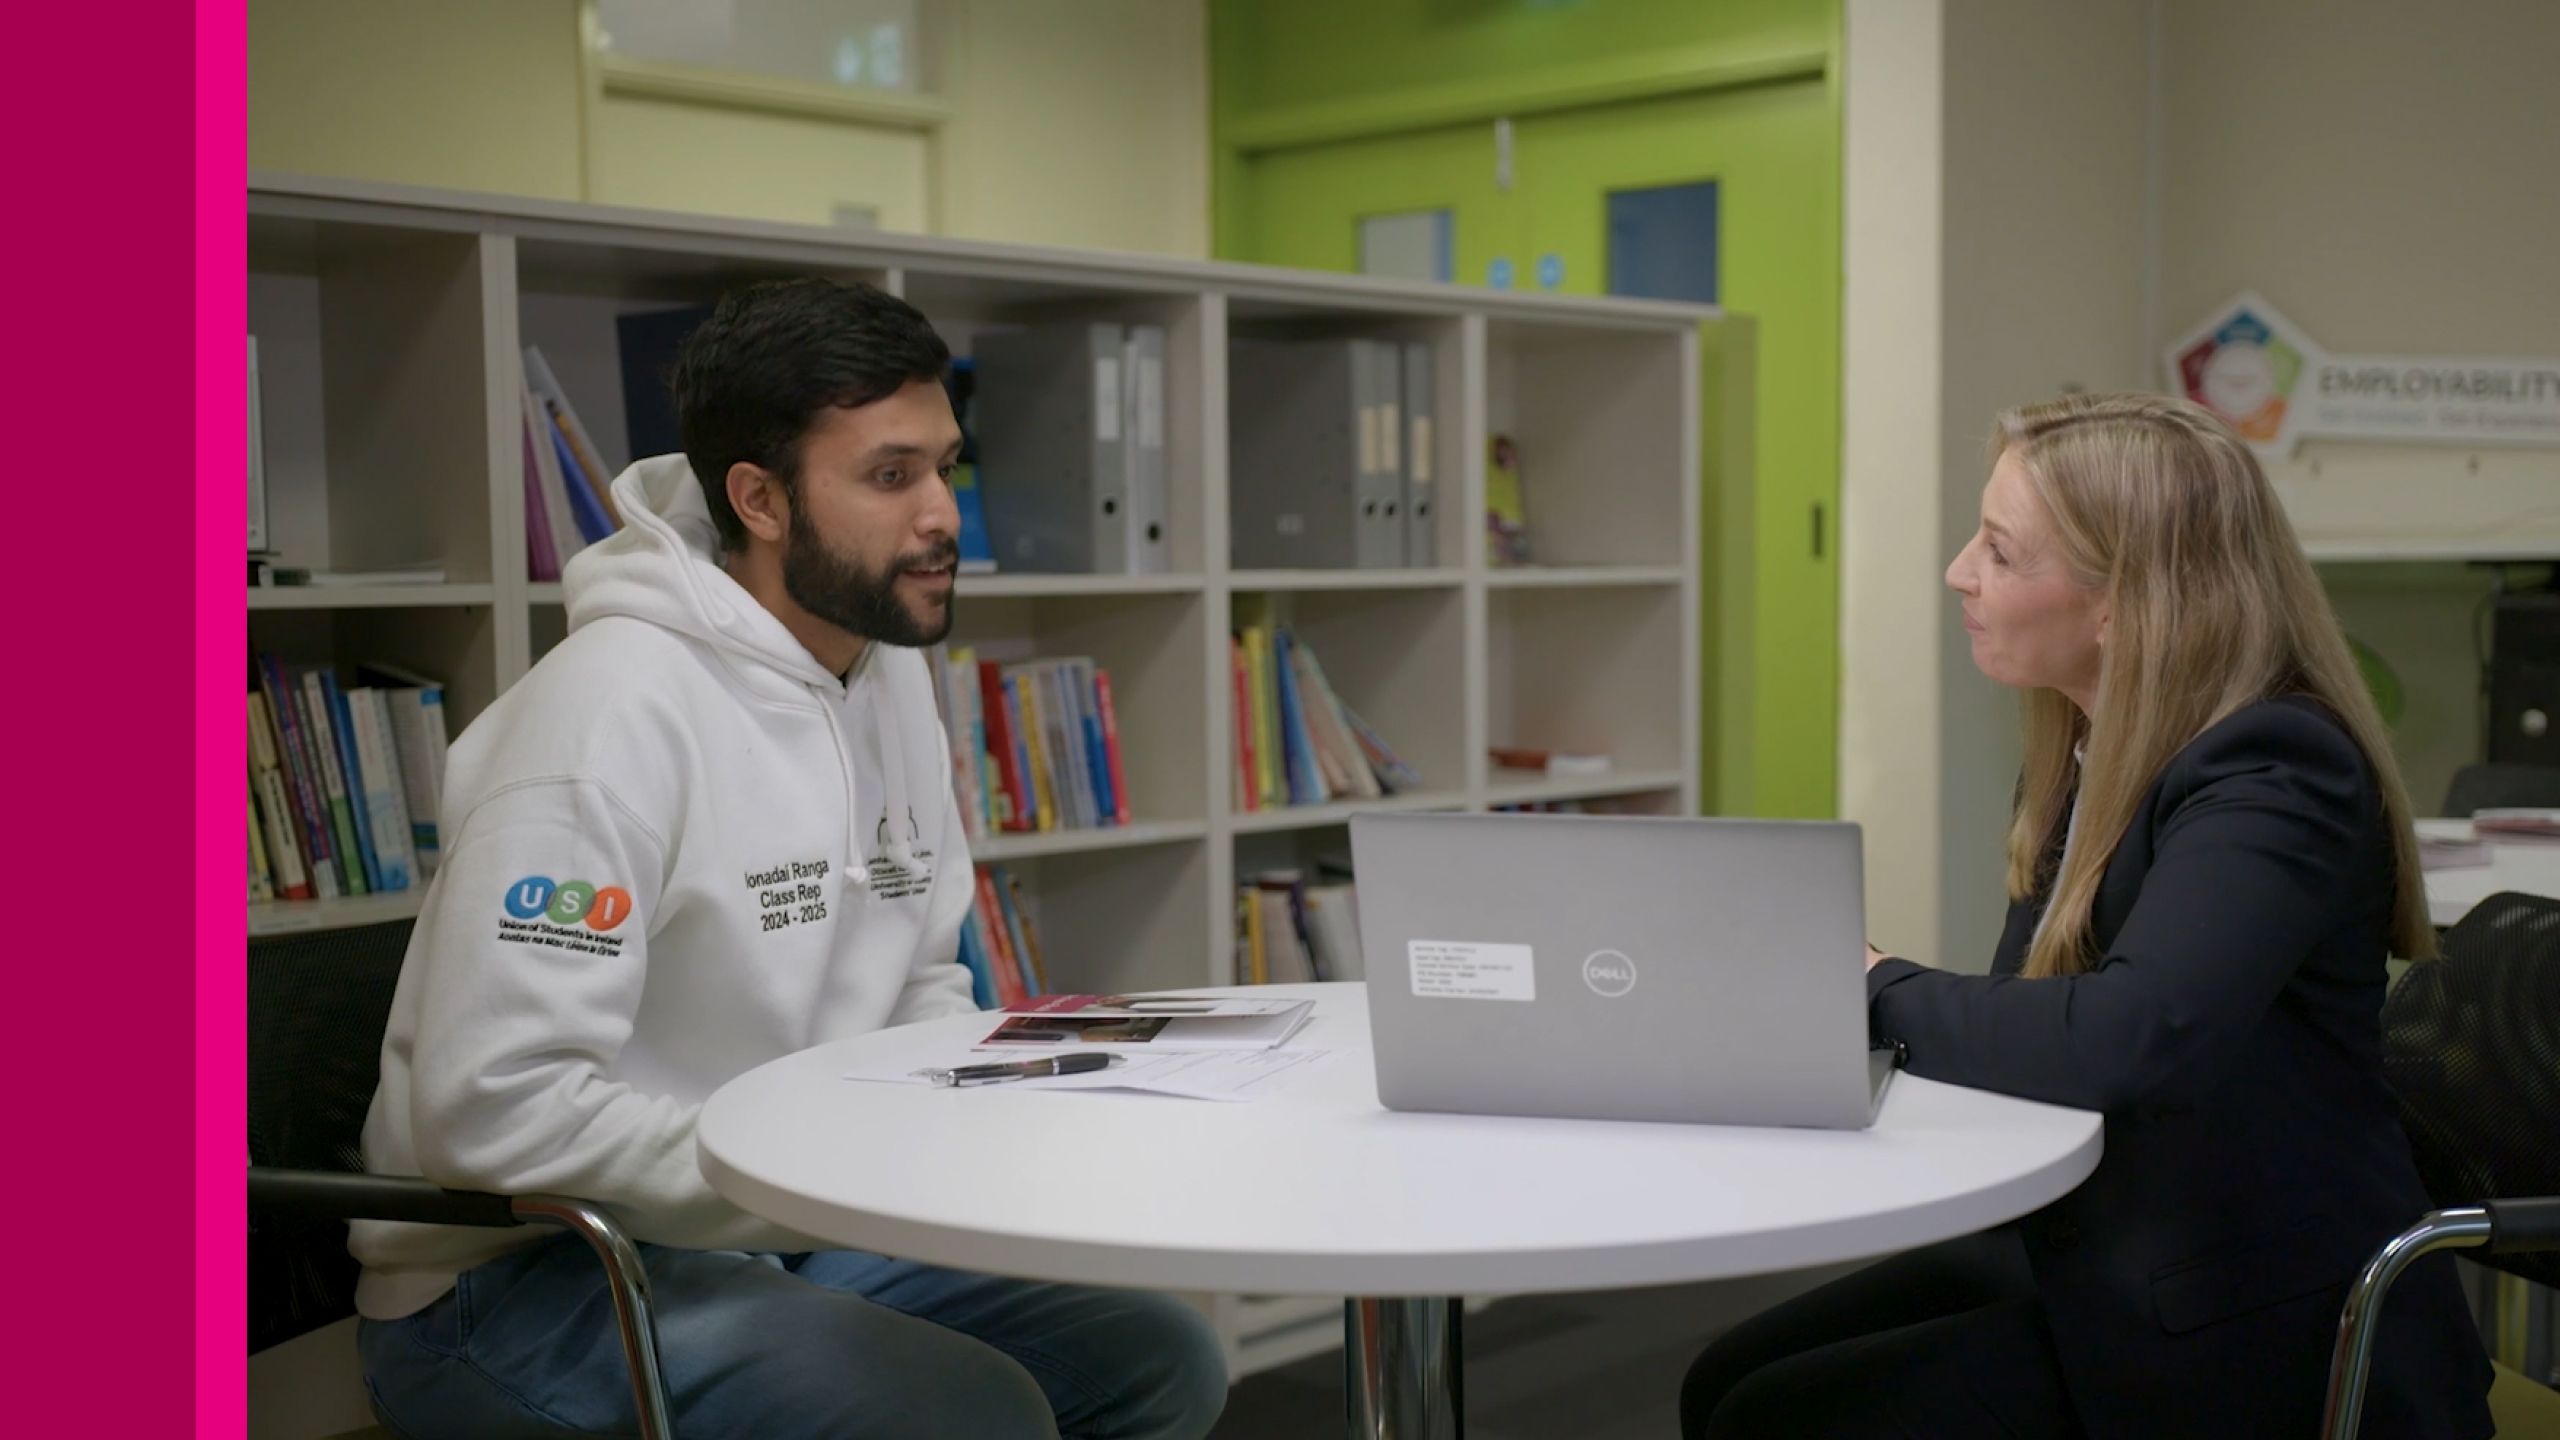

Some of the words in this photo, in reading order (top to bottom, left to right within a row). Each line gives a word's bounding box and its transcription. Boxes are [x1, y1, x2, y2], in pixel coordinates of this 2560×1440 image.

[792, 860, 829, 879] Ranga
[520, 883, 615, 922] USI
[760, 889, 796, 909] Class
[798, 884, 822, 902] Rep
[761, 910, 790, 932] 2024
[800, 902, 827, 923] 2025
[499, 919, 527, 931] Union
[528, 922, 539, 932] of
[540, 923, 584, 940] Students
[586, 931, 594, 941] in
[594, 933, 624, 947] Ireland
